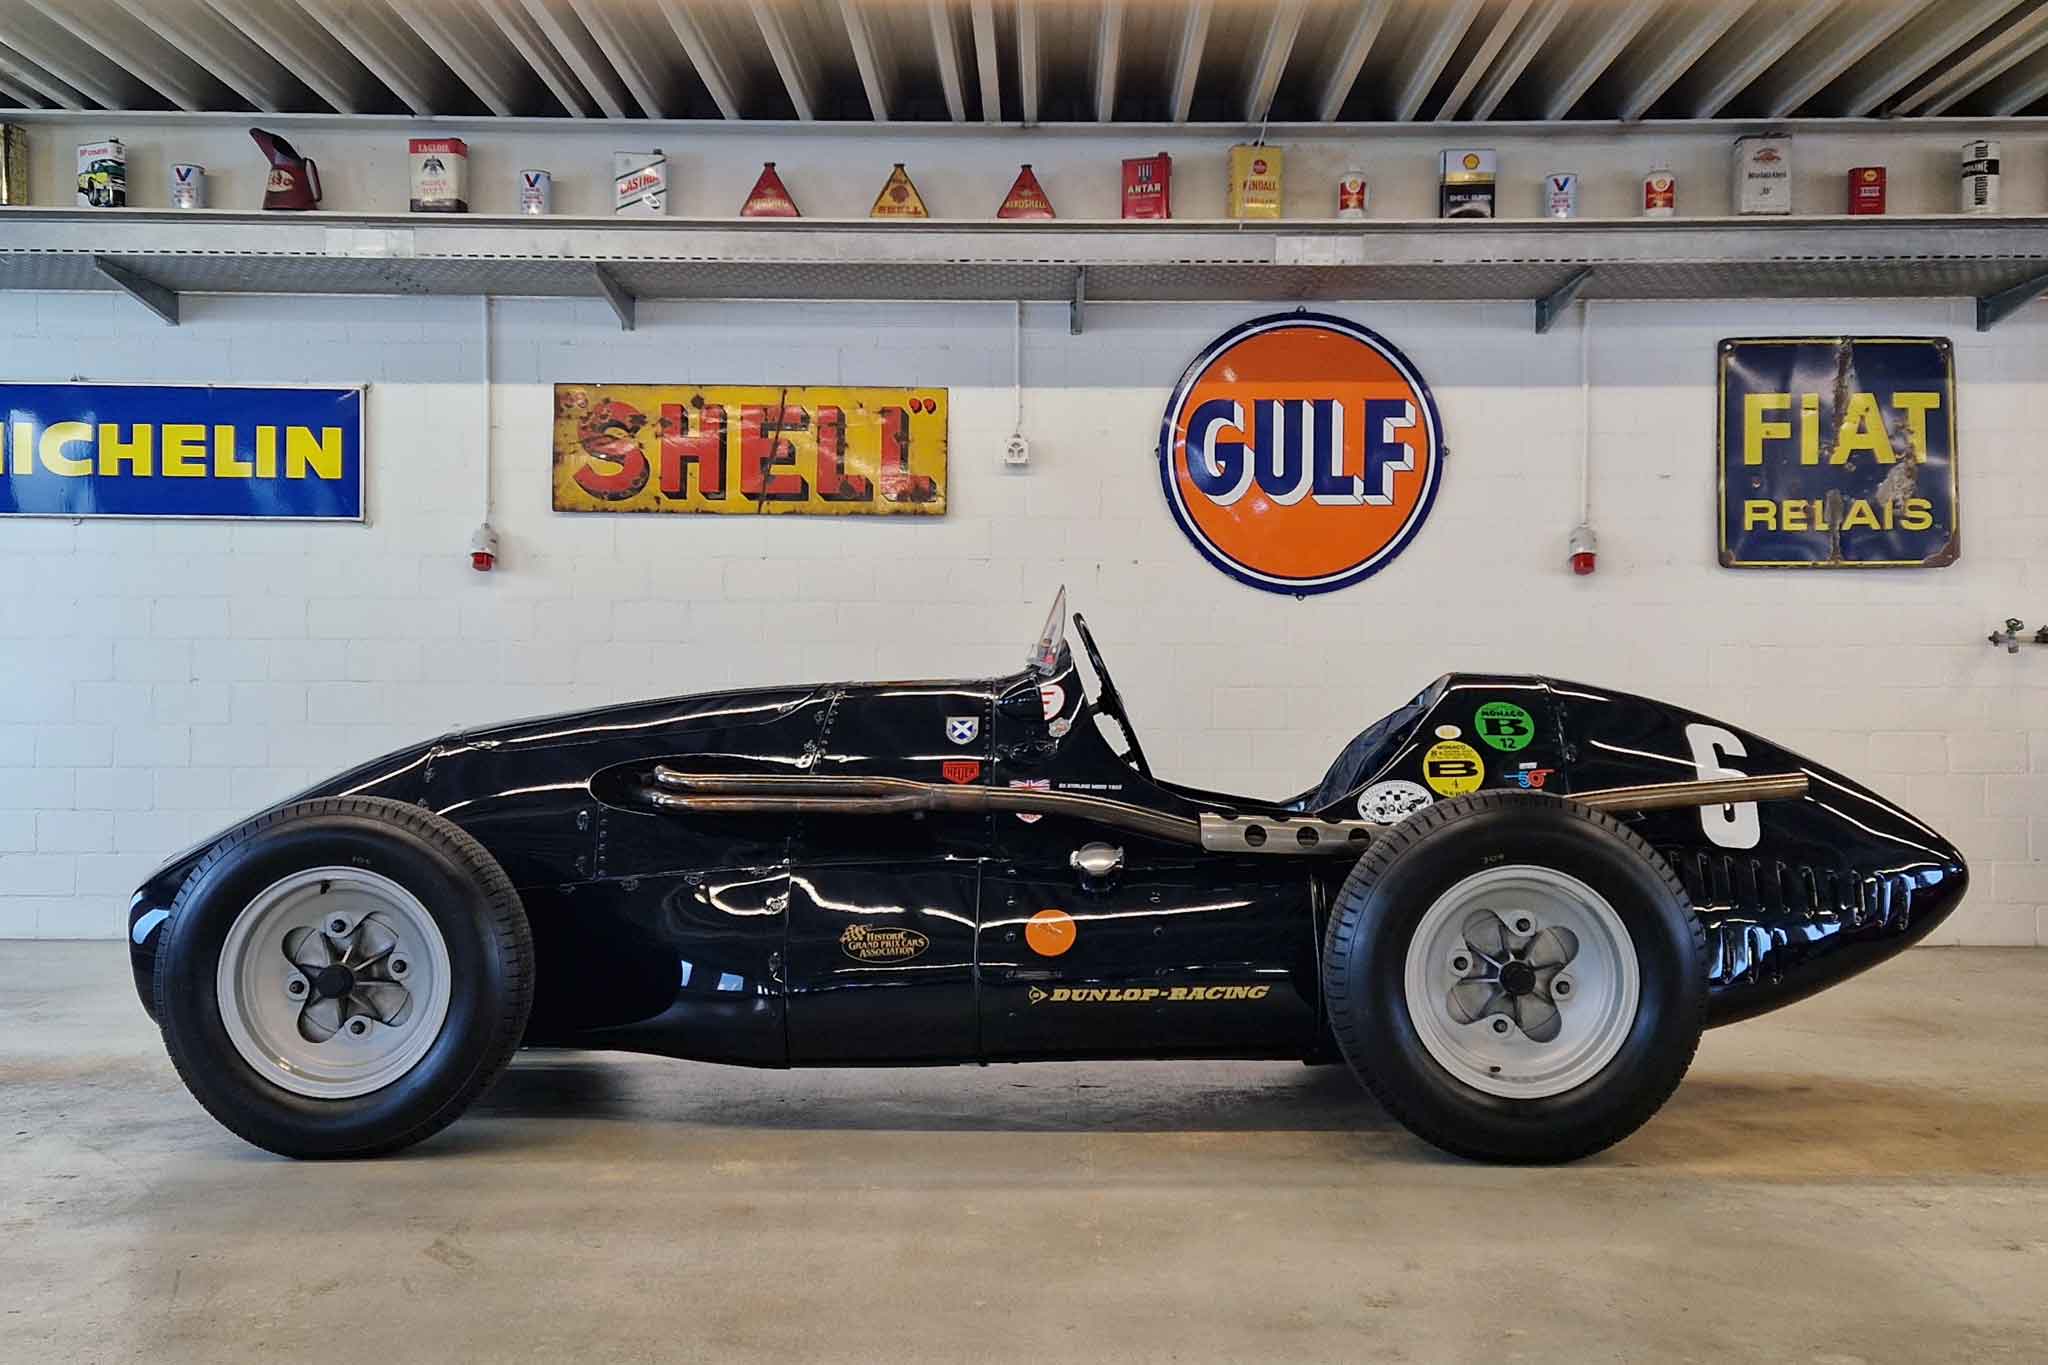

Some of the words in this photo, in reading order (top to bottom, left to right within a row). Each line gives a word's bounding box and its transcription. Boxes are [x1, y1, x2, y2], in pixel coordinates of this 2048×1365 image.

[1974, 143, 1989, 158] OIL
[1974, 175, 1988, 206] MOTOR
[1743, 391, 1941, 466] FIAT
[0, 421, 342, 479] ICHELIN
[1185, 399, 1416, 506] GULF
[1743, 499, 1934, 532] RELAIS
[1481, 710, 1525, 719] MONACO
[1483, 718, 1529, 736] B
[1500, 738, 1518, 749] 12
[1427, 760, 1479, 778] B
[1685, 722, 1761, 850] 6
[848, 941, 879, 950] GRAND
[880, 940, 900, 949] PRIX
[901, 938, 925, 947] CARS
[866, 931, 907, 941] HISTORIC
[860, 947, 914, 958] ASSOCIATION
[1049, 985, 1270, 1002] DUNLOP-RACING
